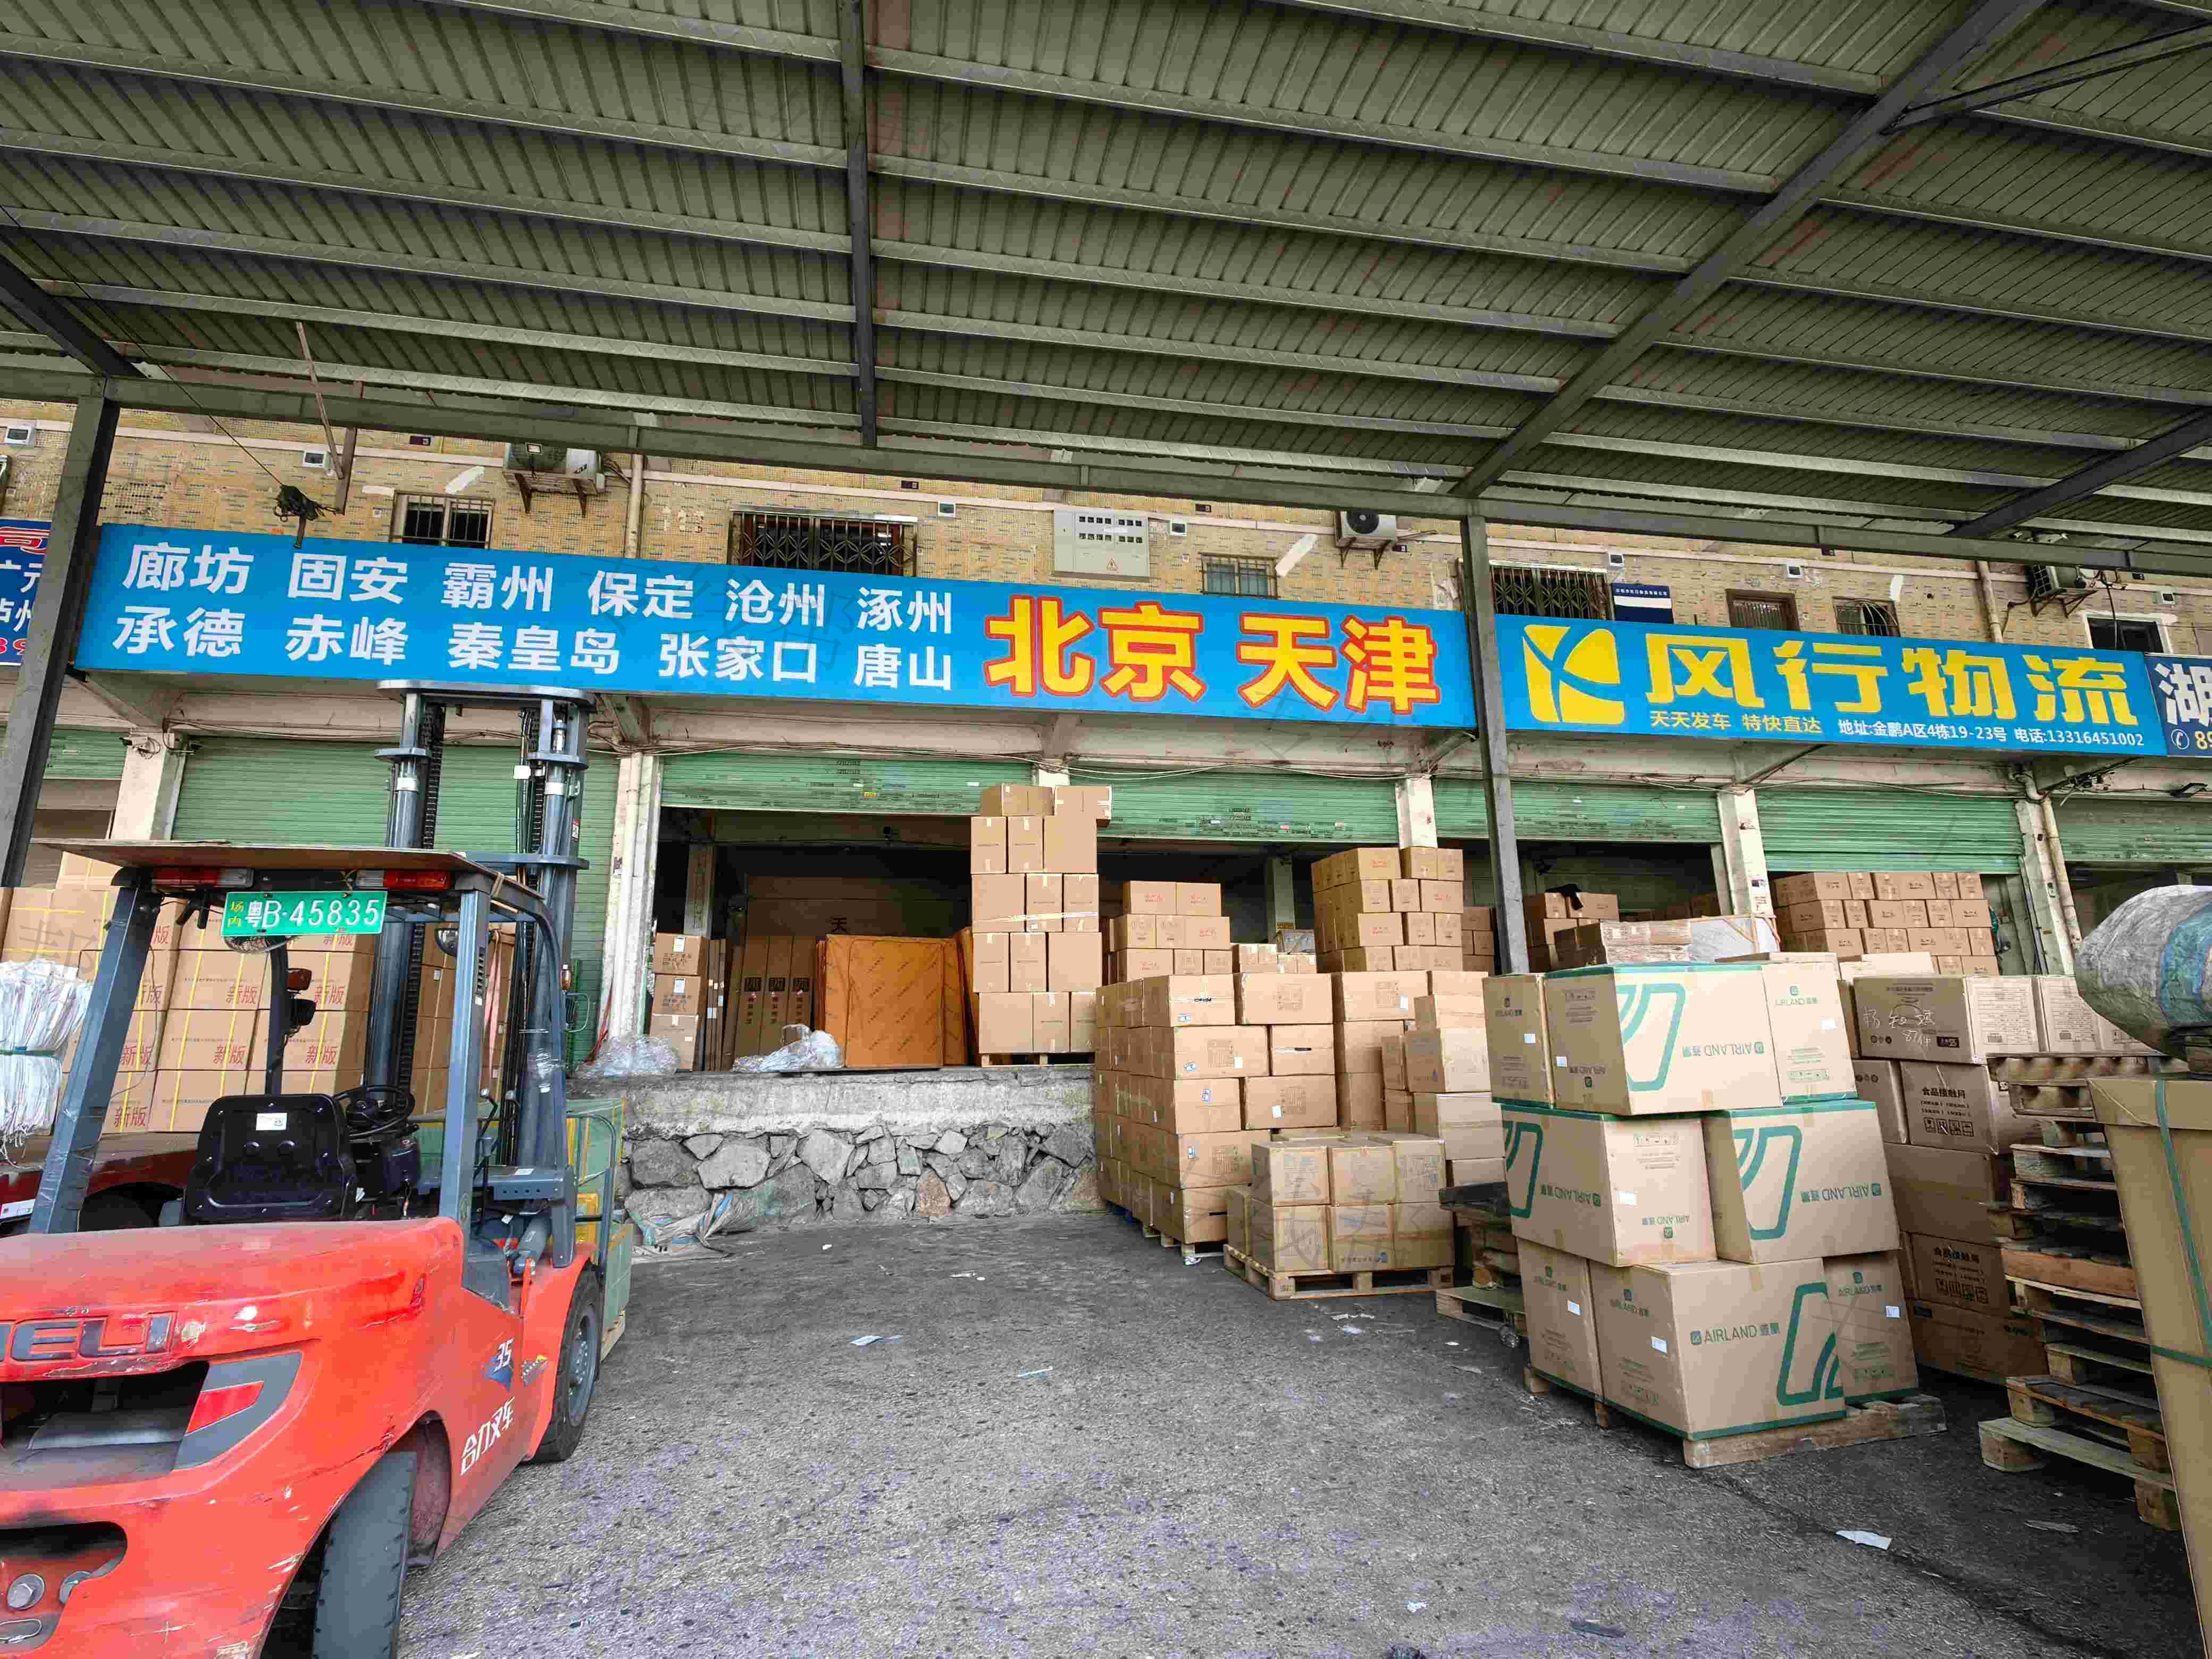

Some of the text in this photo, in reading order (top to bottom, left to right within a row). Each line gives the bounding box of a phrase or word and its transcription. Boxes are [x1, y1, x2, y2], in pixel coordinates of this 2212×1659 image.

[123, 542, 952, 634] 廊坊 固安 霸州 保定 沧州 涿州
[112, 605, 952, 690] 承德 赤峰 秦皇岛 张家口 唐山
[984, 595, 1442, 715] 北京 天津
[1645, 632, 2139, 726] 风行物流
[1650, 710, 1823, 734] 天天发车 特快直达
[2014, 727, 2144, 746] 电话:13316451002
[1822, 1182, 1869, 1201] AIRLAND
[0, 1312, 175, 1361] ELI
[493, 1337, 514, 1373] 35
[1704, 1325, 1757, 1343] AIRLAND
[460, 1396, 515, 1476] 合力叉车
